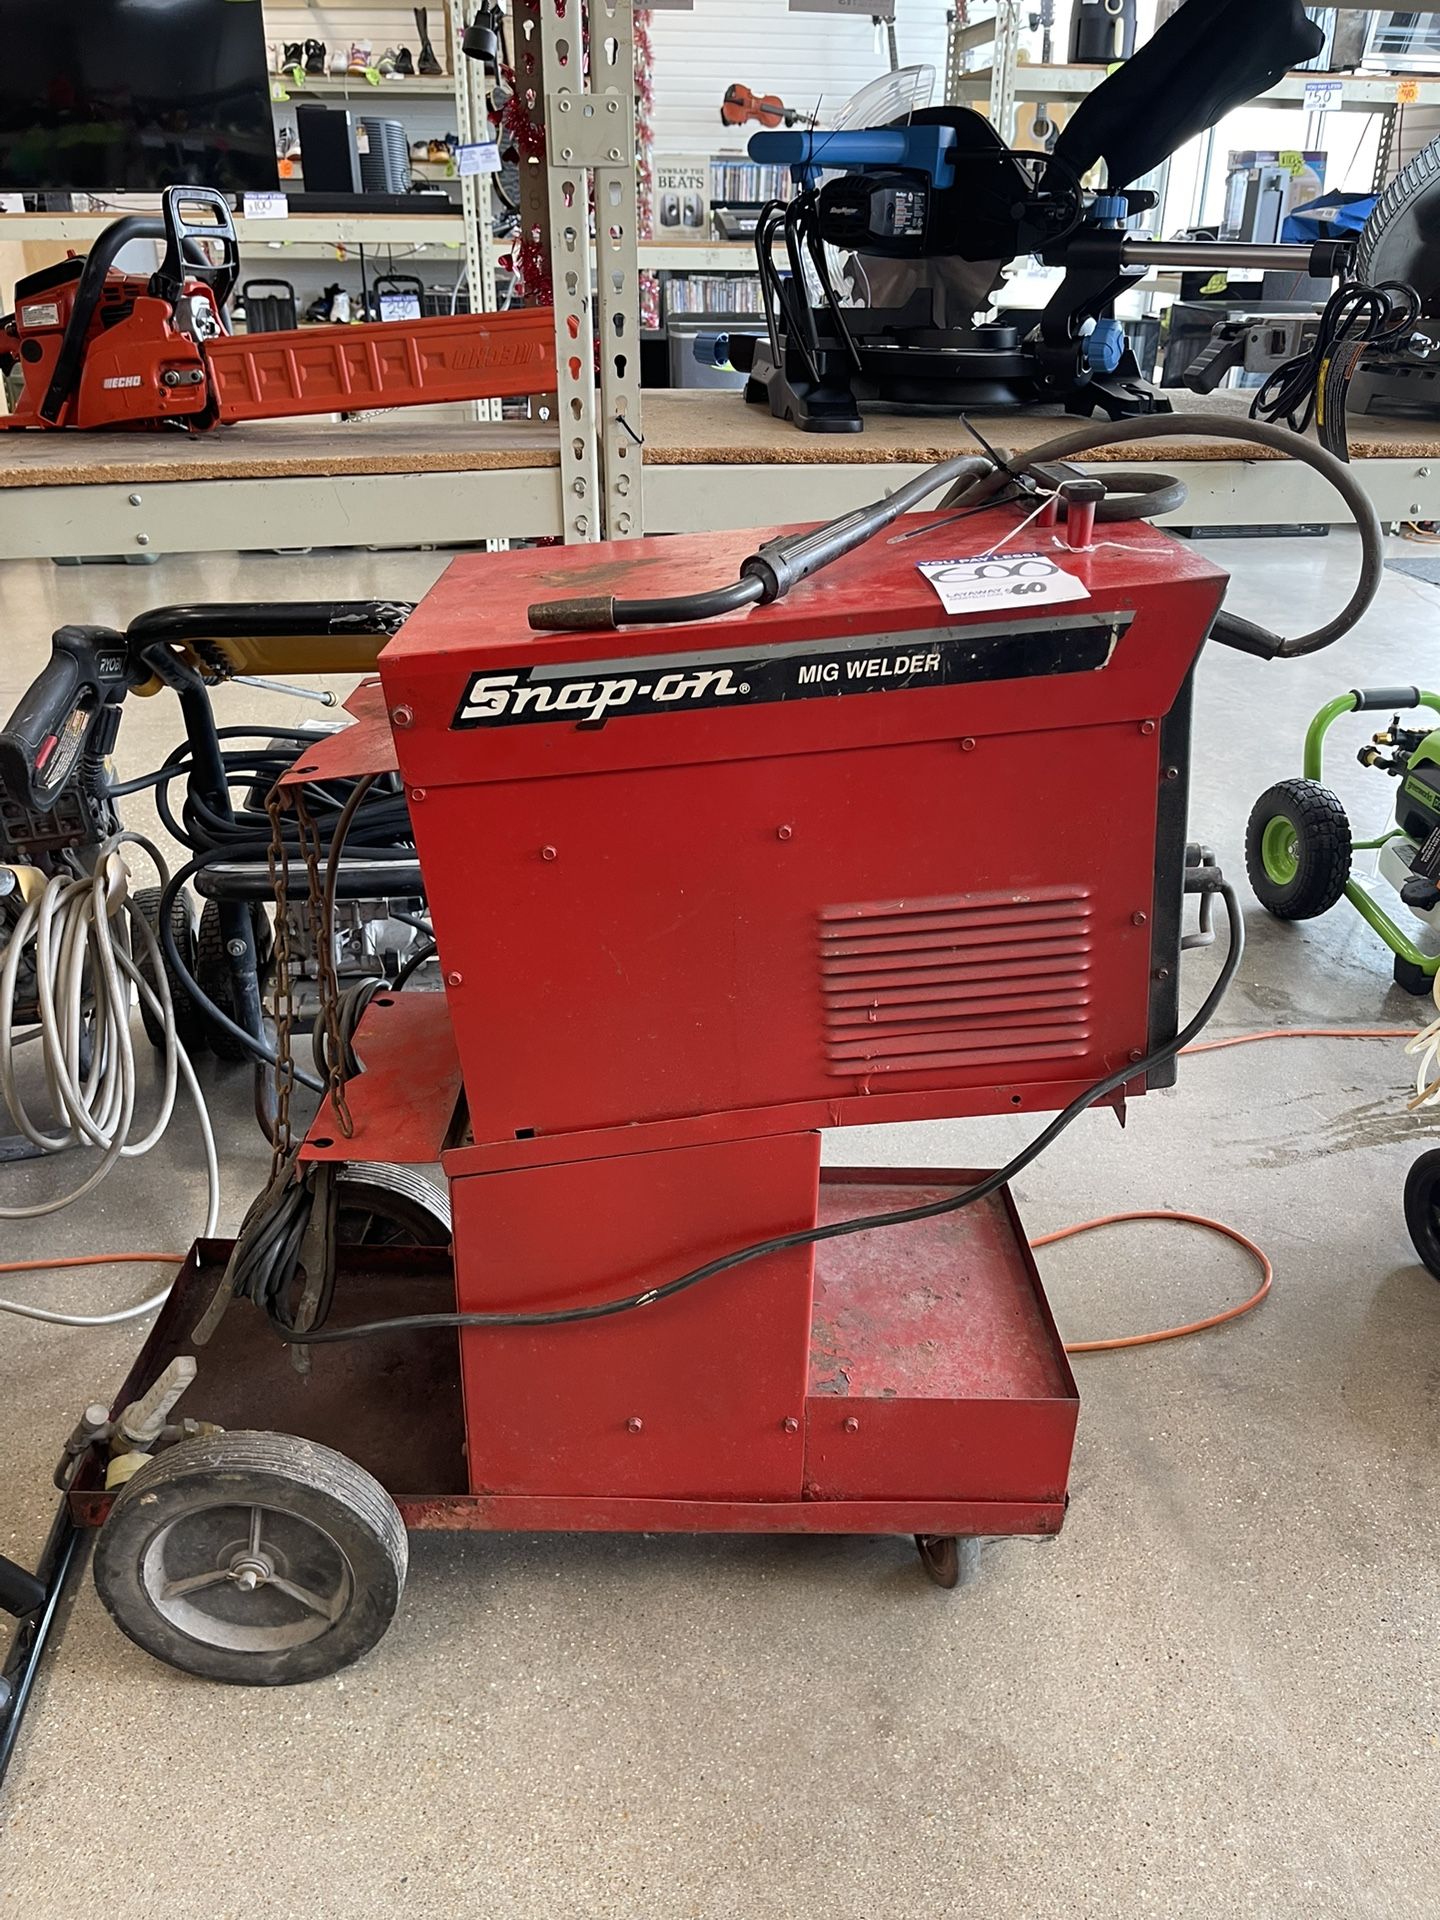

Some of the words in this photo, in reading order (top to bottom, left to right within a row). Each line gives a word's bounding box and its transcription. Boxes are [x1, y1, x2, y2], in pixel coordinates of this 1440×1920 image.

[658, 175, 704, 189] BEATS
[112, 376, 141, 388] ECHO
[958, 556, 989, 564] PAY
[100, 657, 123, 673] RYOBI
[798, 662, 840, 684] MIG
[847, 653, 941, 680] WELDER
